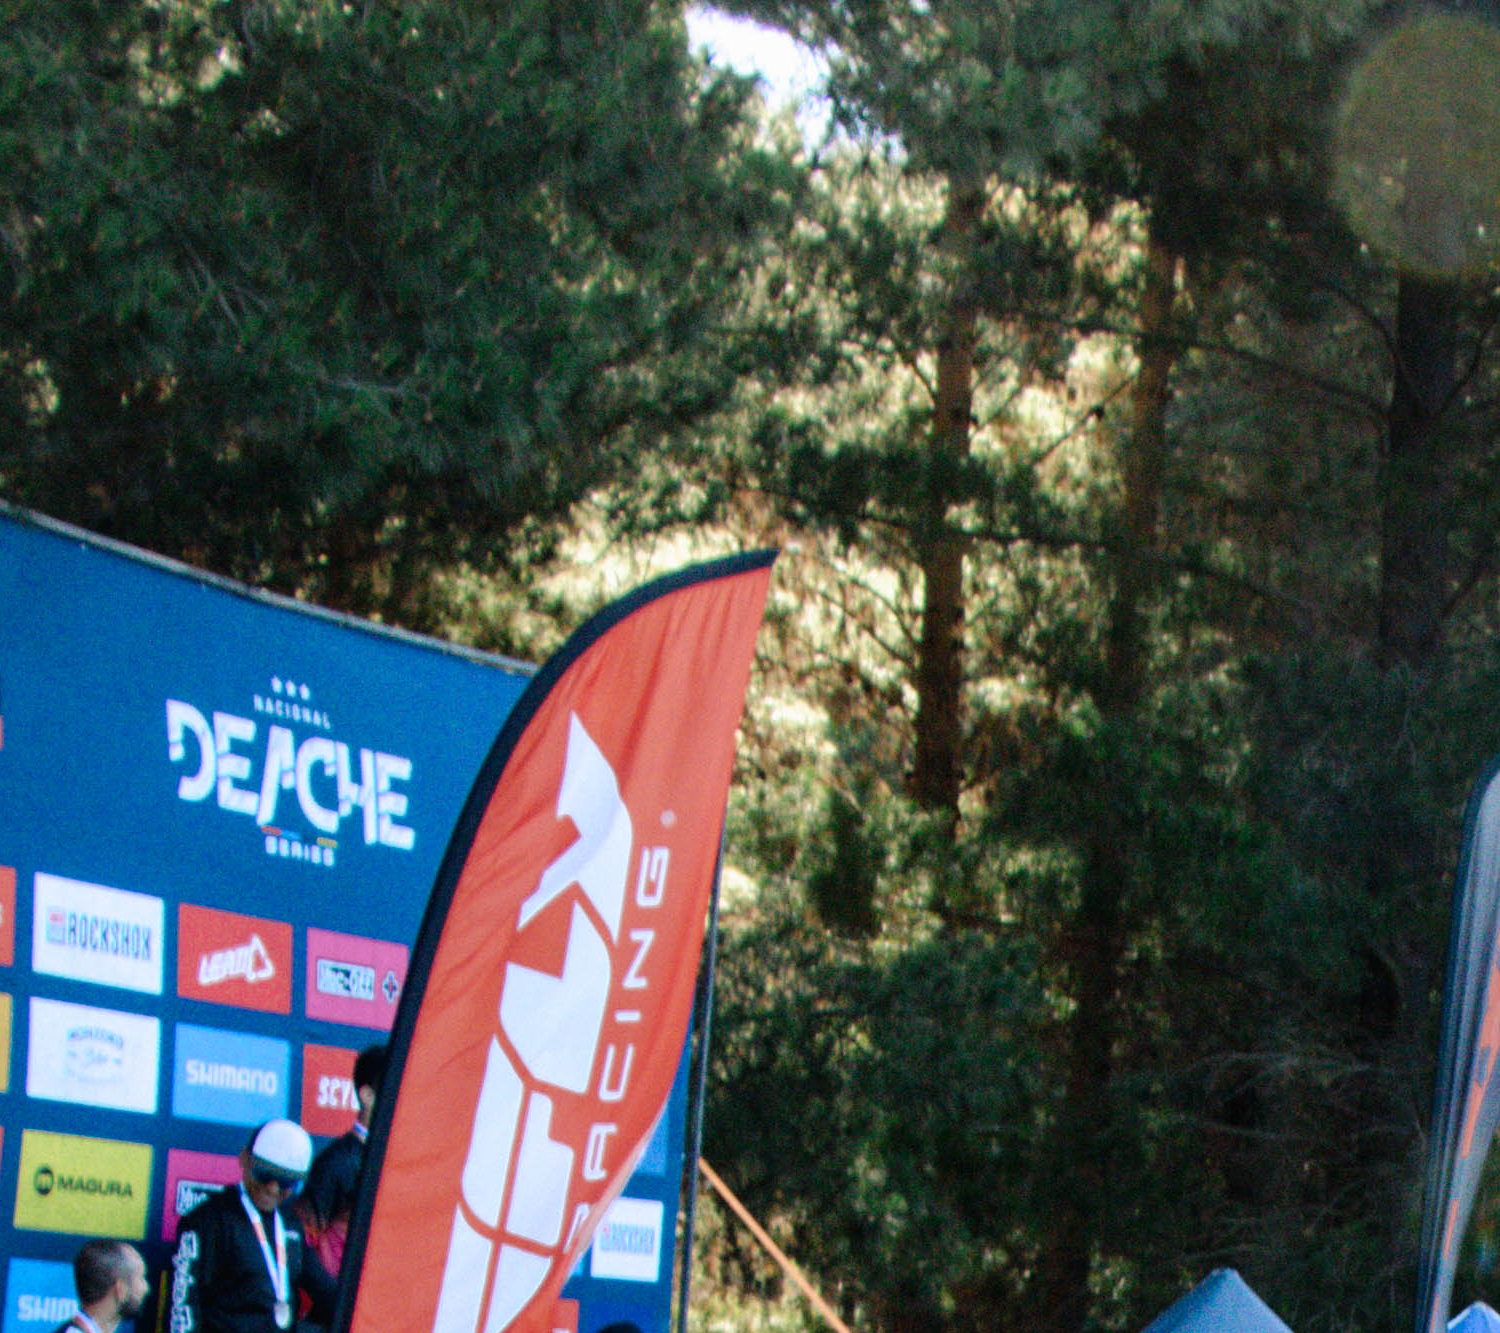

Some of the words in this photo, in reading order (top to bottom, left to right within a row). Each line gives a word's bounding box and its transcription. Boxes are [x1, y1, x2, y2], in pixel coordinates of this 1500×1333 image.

[254, 694, 331, 731] NACIONAL
[166, 699, 415, 851] DEACHE
[265, 834, 334, 868] SERIES
[66, 910, 152, 960] ROCKSHOX
[184, 1058, 278, 1097] SHIMANO
[57, 1173, 134, 1199] MAGURA
